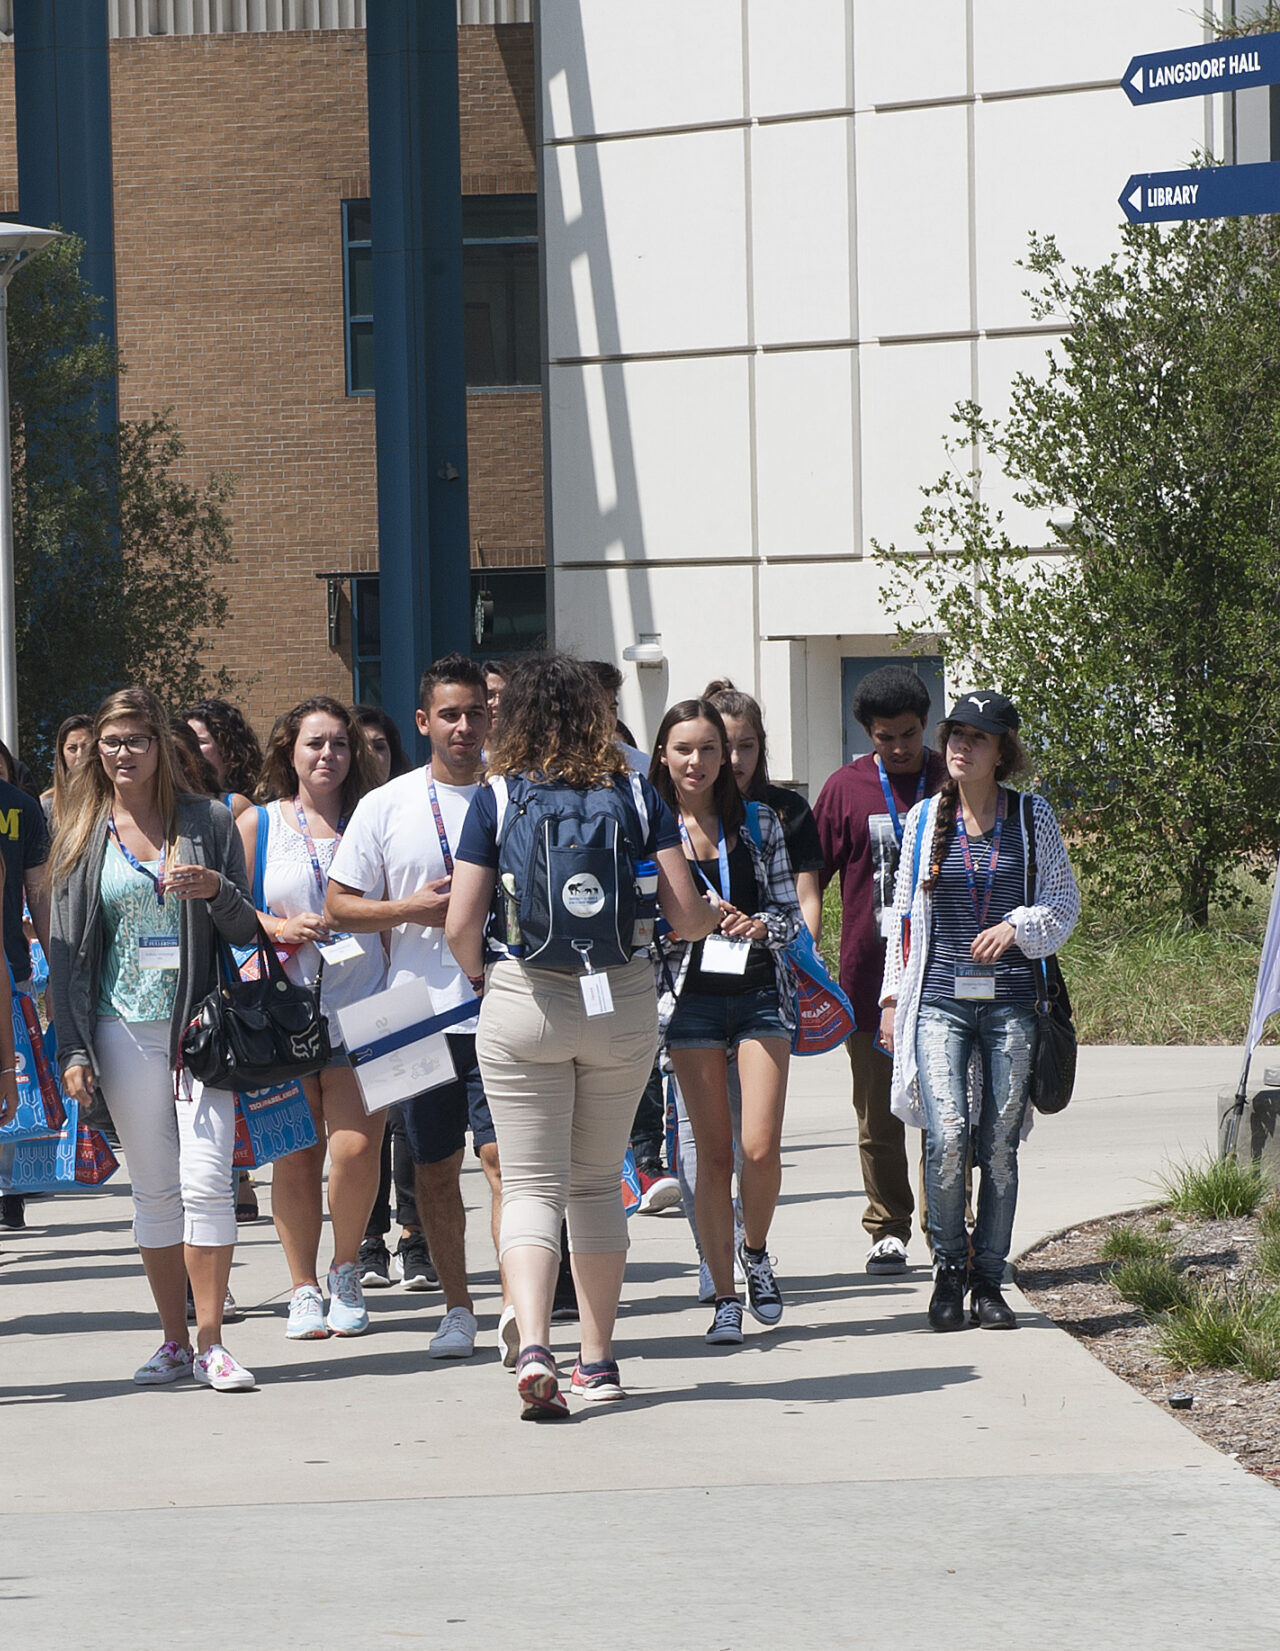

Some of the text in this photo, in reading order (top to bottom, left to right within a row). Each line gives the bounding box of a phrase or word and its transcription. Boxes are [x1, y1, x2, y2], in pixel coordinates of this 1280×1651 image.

[1149, 51, 1261, 88] LANGSDORF HALL
[1147, 184, 1199, 207] LIBRARY
